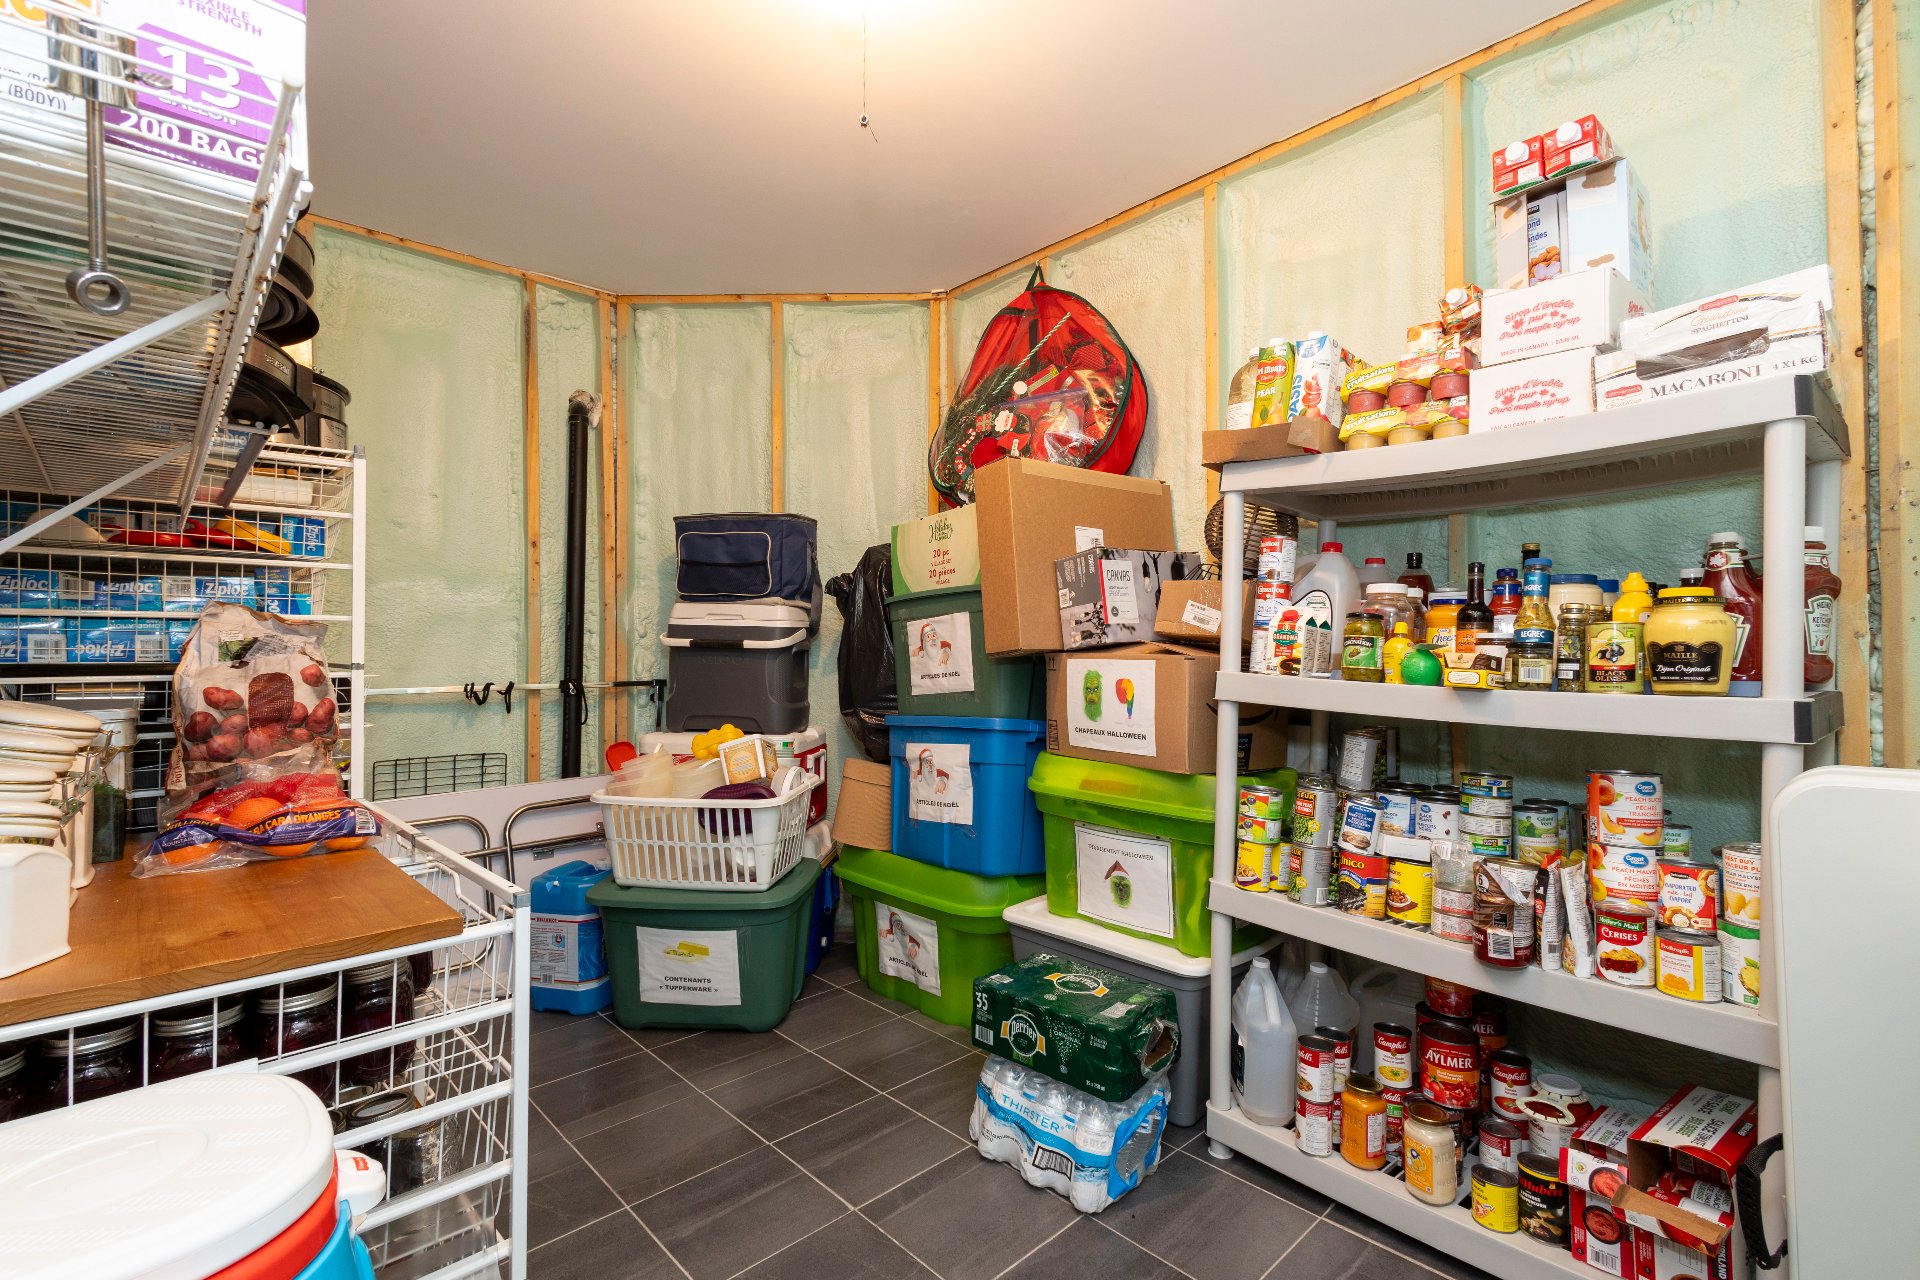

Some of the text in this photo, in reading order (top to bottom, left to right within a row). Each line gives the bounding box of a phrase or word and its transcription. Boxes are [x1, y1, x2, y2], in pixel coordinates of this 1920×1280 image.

[157, 45, 242, 110] 13
[119, 109, 182, 147] 200
[1528, 231, 1548, 243] ndes
[1504, 299, 1575, 324] Sirop d'érable
[1528, 313, 1548, 325] pur
[1690, 313, 1751, 336] SPAGHETTINI
[1499, 316, 1581, 342] Pure maple syrup
[1500, 349, 1517, 358] MADE
[1525, 341, 1549, 352] CANADA
[1801, 354, 1819, 366] KG
[1264, 364, 1287, 374] Monte
[1346, 365, 1396, 390] Fruitsations
[1650, 364, 1762, 400] MACARONI
[1256, 386, 1277, 398] PEAR
[1494, 378, 1564, 400] Sirop d'érable
[1517, 391, 1538, 403] pur
[1488, 395, 1571, 416] Pure maple syrup
[1346, 408, 1398, 432] Fruitsations
[306, 525, 320, 552] Ziploc
[932, 548, 941, 559] 20
[928, 568, 937, 579] 20
[1106, 569, 1131, 582] CANVAS
[205, 582, 250, 598] Ziploc
[1257, 584, 1286, 596] Carnation
[1816, 601, 1833, 611] HEINZ
[75, 640, 126, 658] Ziploc
[1656, 664, 1713, 675] Dijon Originale
[920, 672, 941, 681] ARTICLES
[1074, 726, 1147, 742] CHAPEAUX HALLOWEEN
[1637, 783, 1655, 791] Great
[265, 814, 293, 831] CARA
[293, 809, 342, 825] ORANGES
[1121, 850, 1154, 862] HALLOWEEN
[1625, 854, 1645, 862] Great
[1738, 856, 1756, 865] BUY
[1611, 866, 1636, 874] PEACH
[1477, 873, 1484, 887] 6
[1617, 881, 1629, 889] EN
[664, 975, 712, 985] CONTENANTS
[664, 984, 713, 993] TUPPERWARE
[975, 991, 989, 1011] 35
[1011, 1018, 1037, 1042] perrier
[1471, 1022, 1496, 1035] MER
[1425, 1048, 1473, 1069] AYLMER
[1001, 1094, 1061, 1133] THIRSTER
[1718, 1242, 1728, 1280] RKLAND
